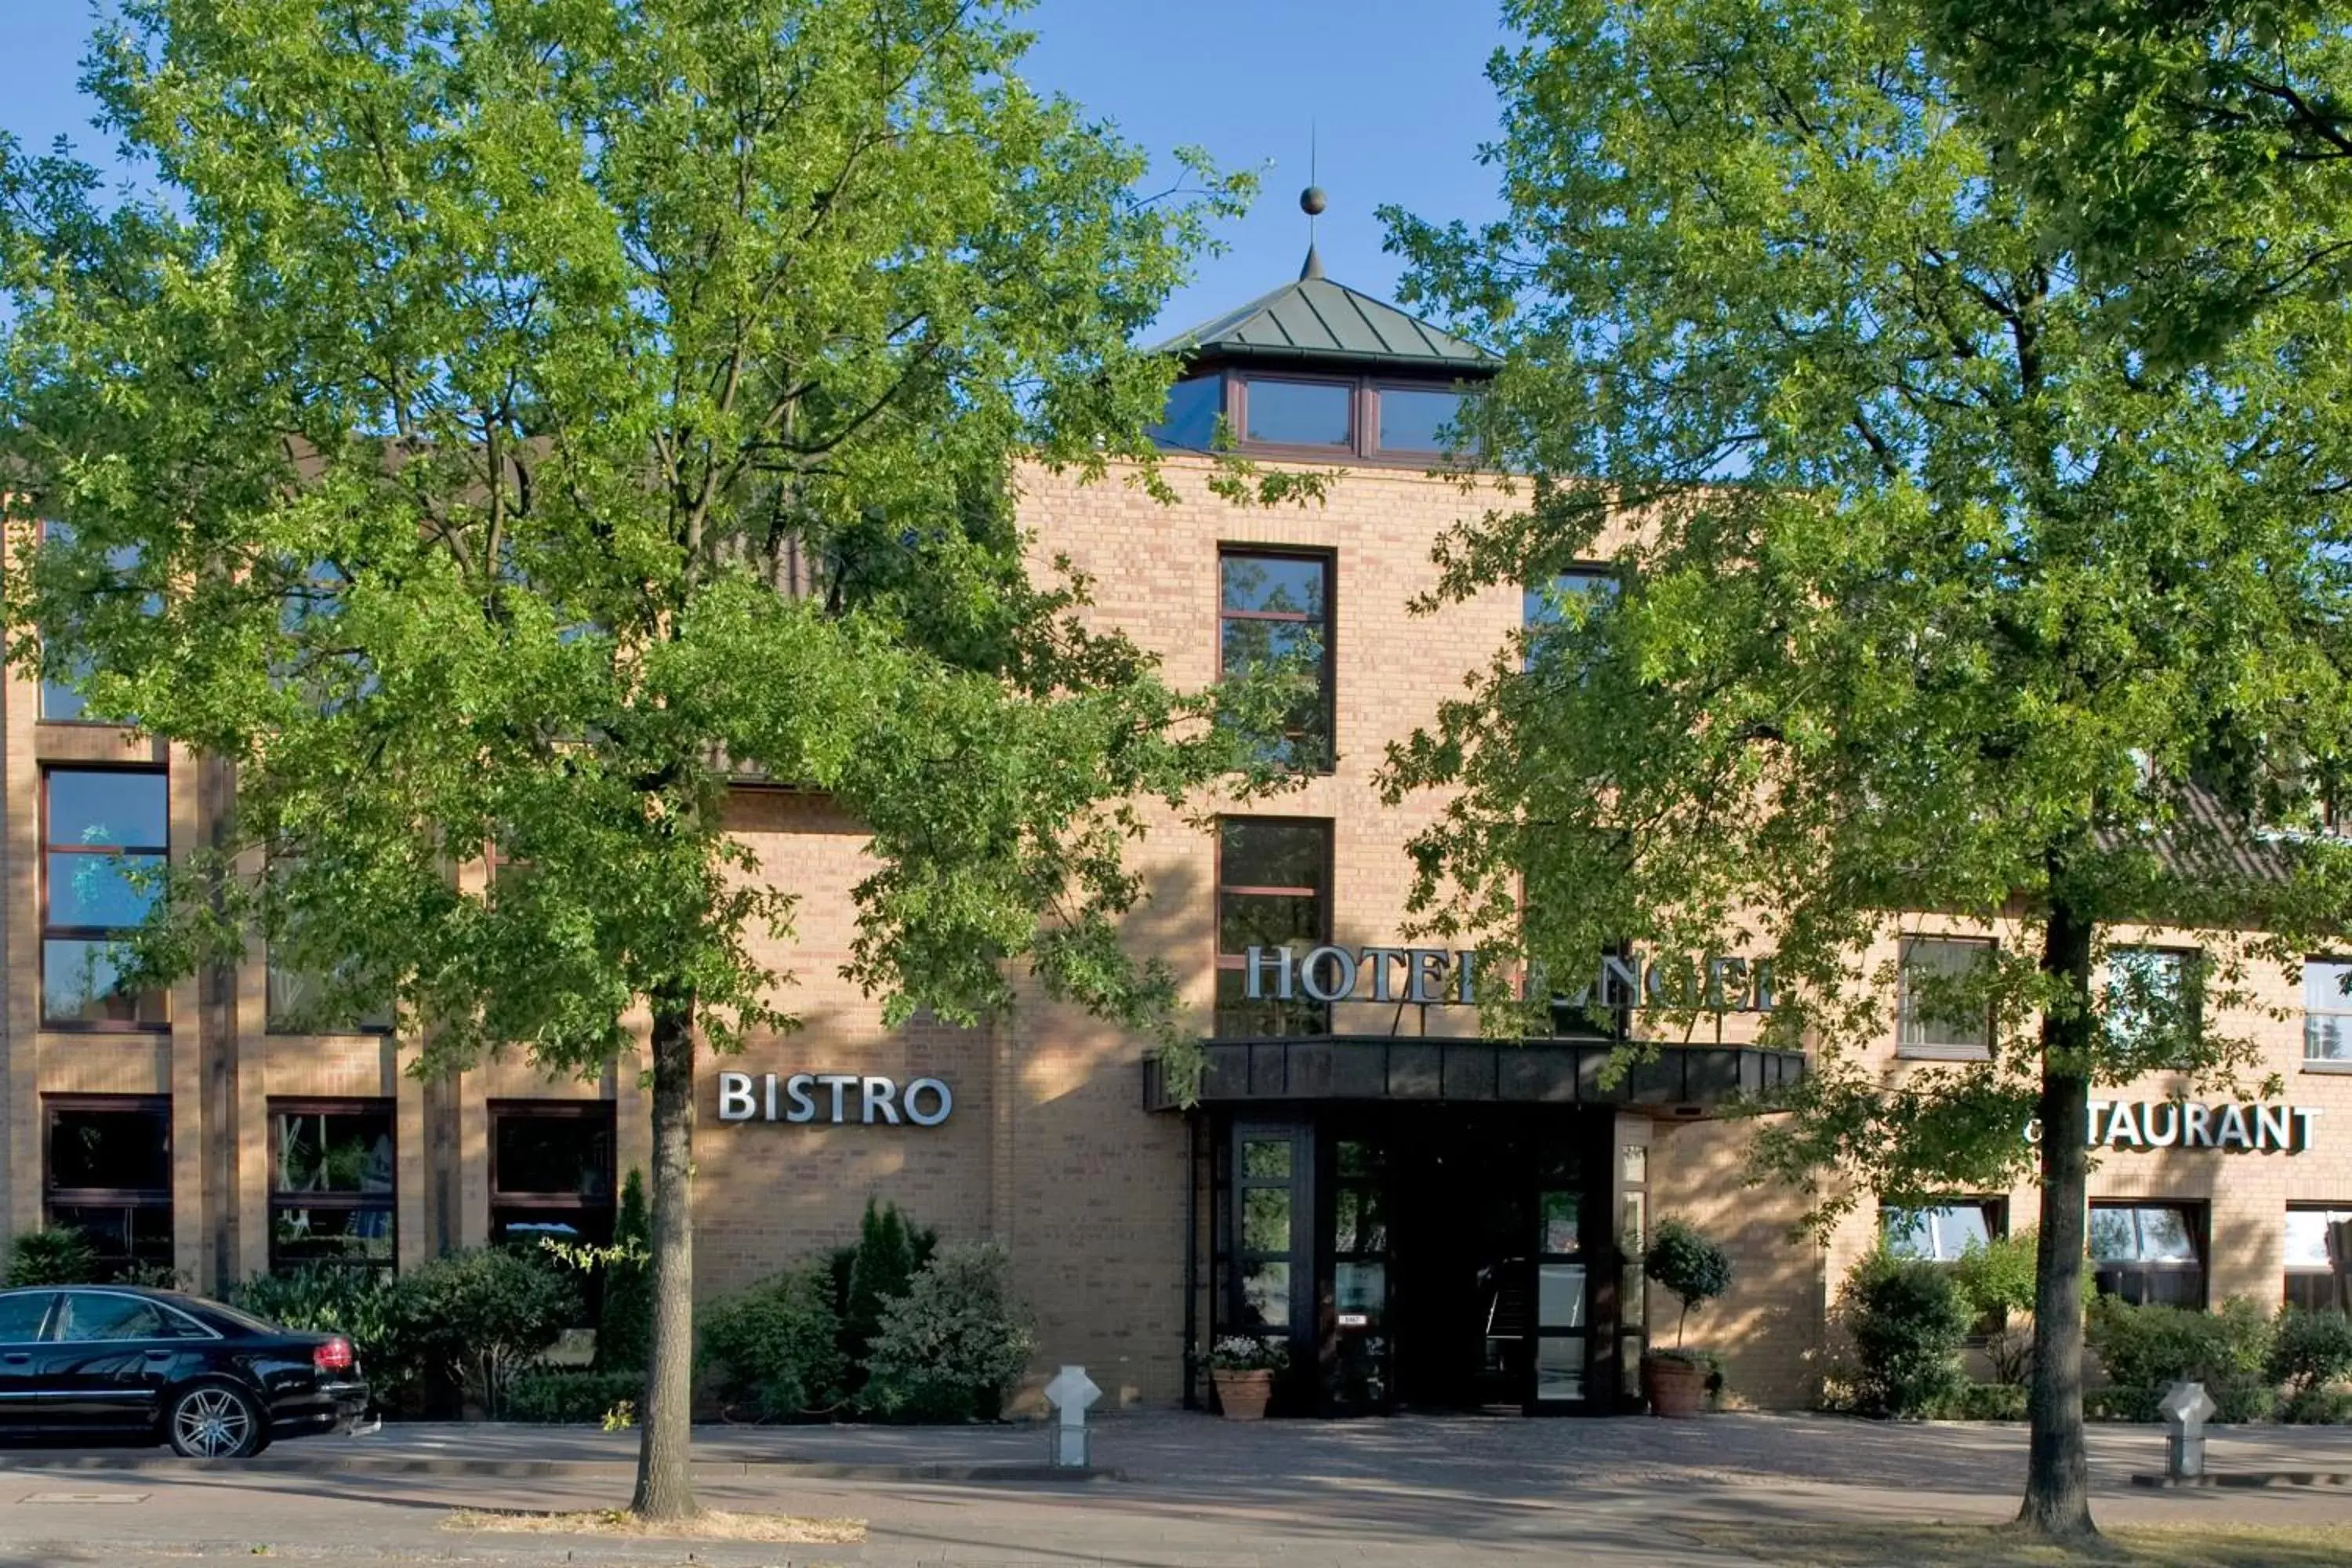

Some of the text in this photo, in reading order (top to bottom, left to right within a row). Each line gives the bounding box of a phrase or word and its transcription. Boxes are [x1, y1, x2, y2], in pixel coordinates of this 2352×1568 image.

[1529, 953, 1775, 1011] NGE
[718, 1071, 954, 1126] BISTRO
[2024, 1100, 2324, 1149] TAURANT
